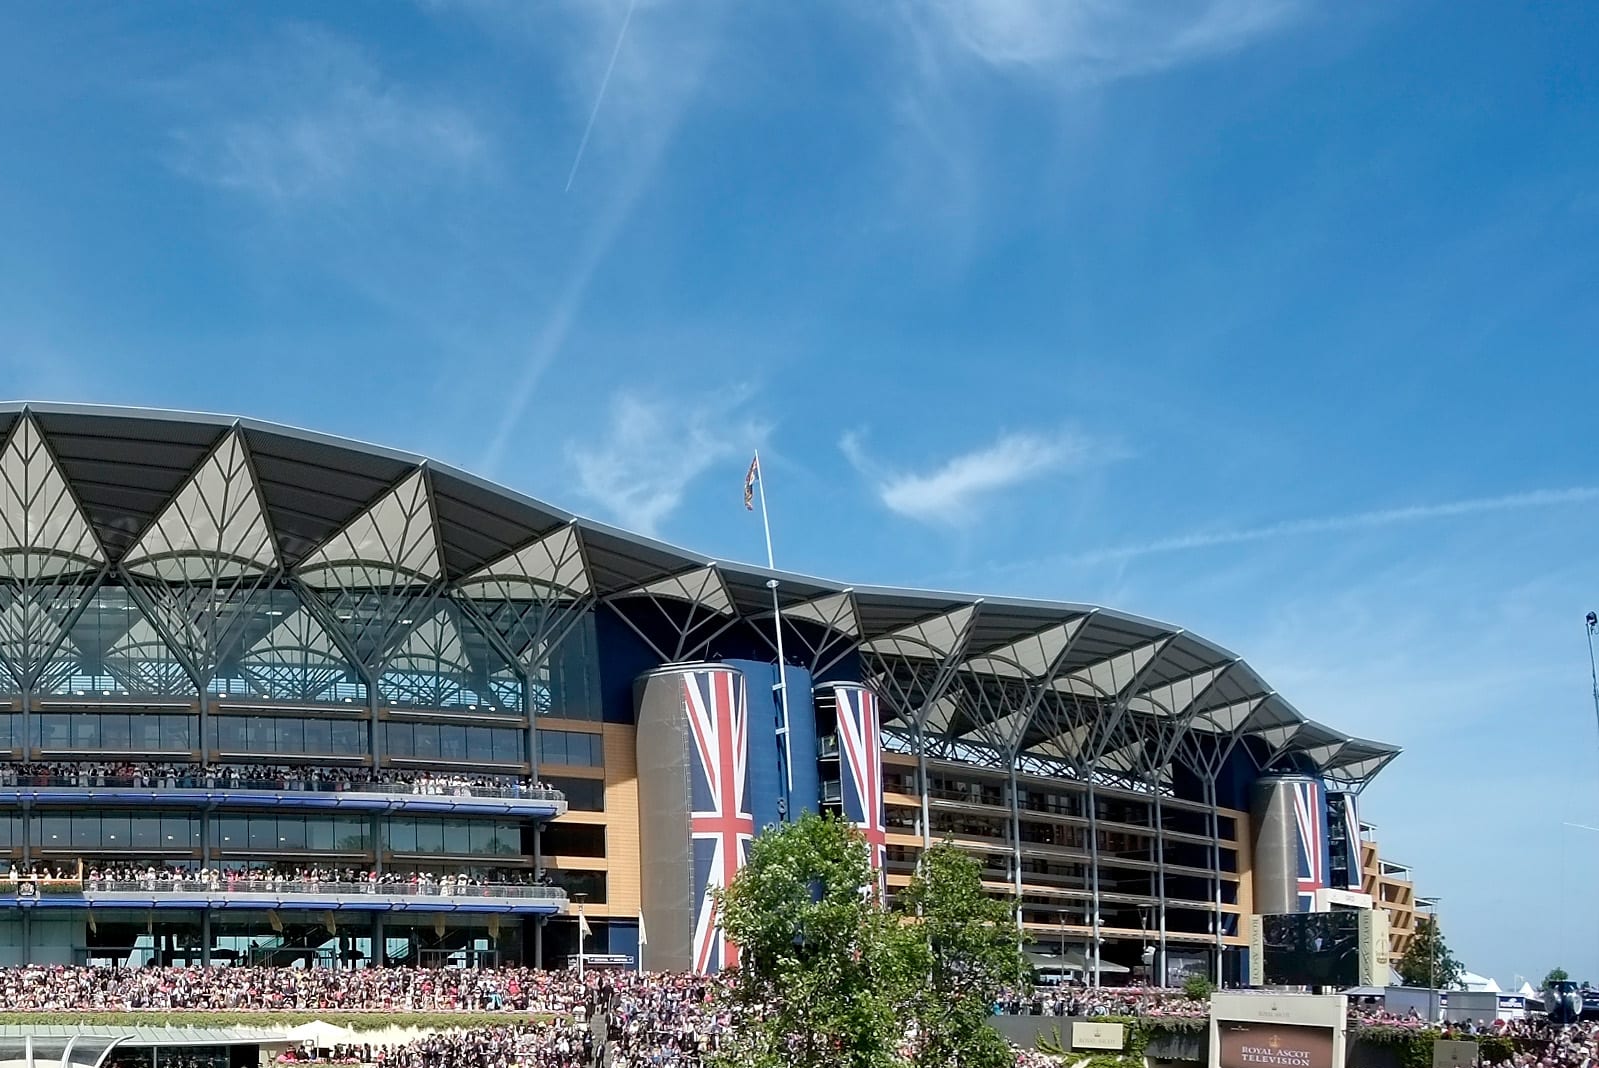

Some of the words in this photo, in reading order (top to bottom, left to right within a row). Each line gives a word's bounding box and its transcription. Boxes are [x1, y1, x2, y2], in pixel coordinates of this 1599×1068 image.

[1241, 1046, 1274, 1056] ROYAL
[1276, 1049, 1311, 1059] ASCOT
[1241, 1053, 1310, 1067] TELEVISION
